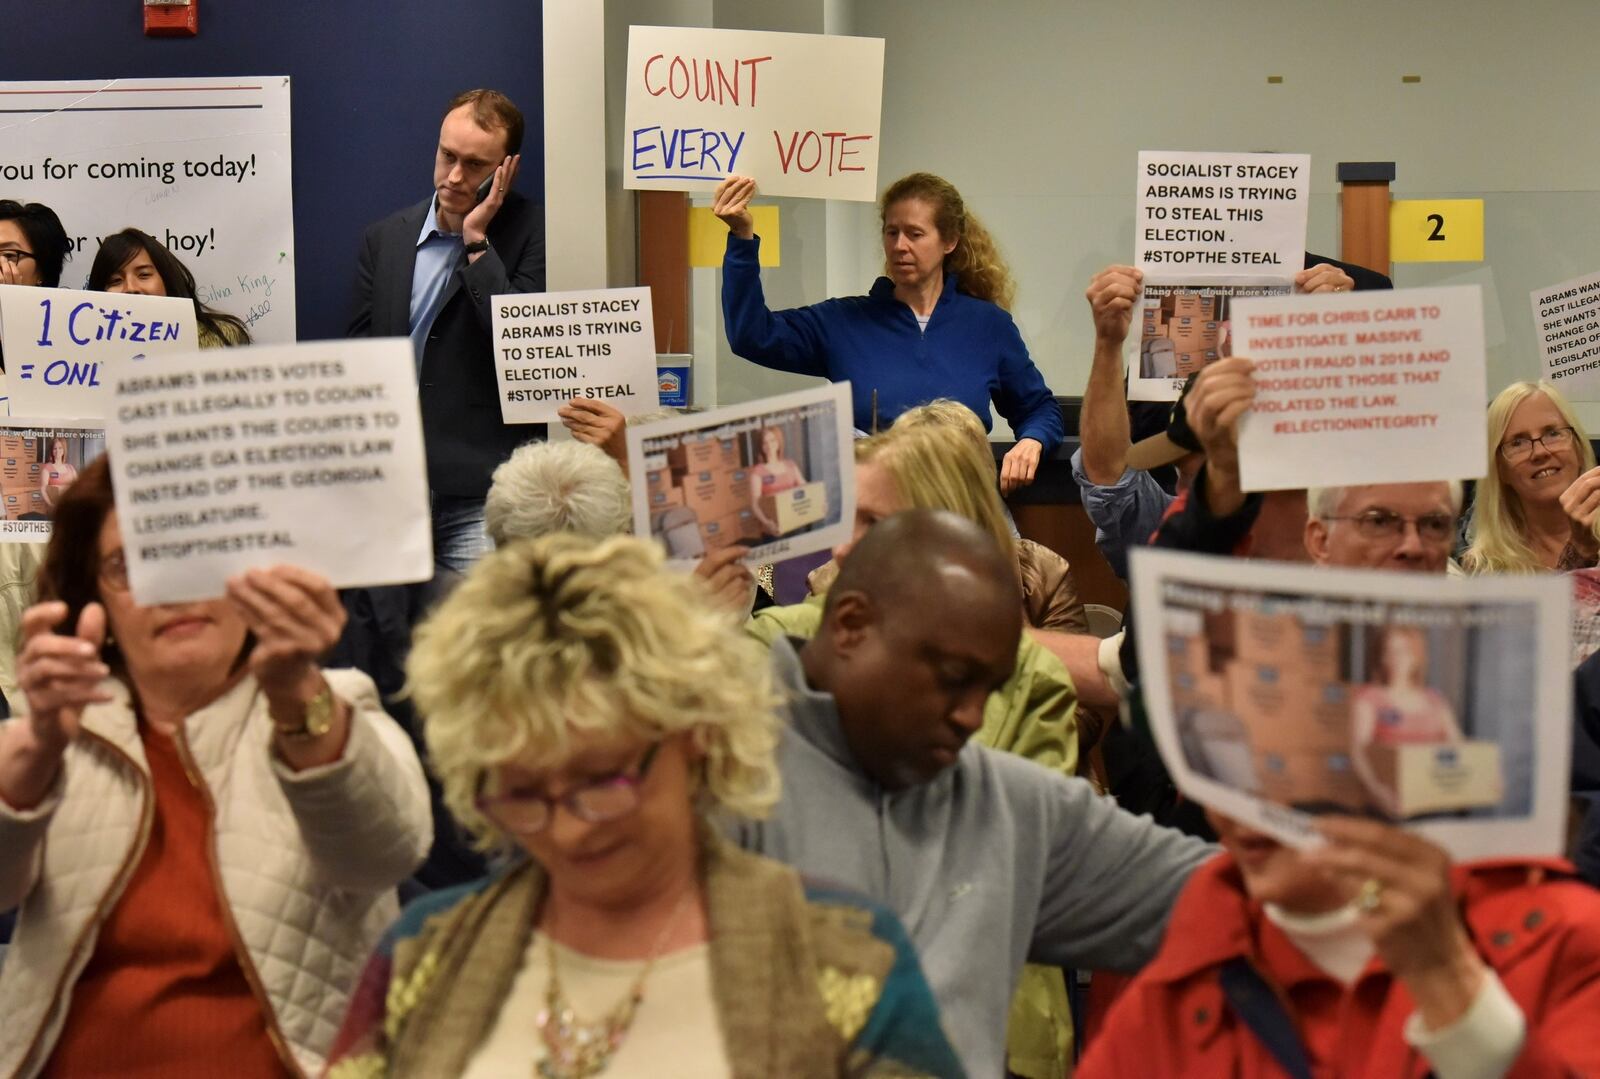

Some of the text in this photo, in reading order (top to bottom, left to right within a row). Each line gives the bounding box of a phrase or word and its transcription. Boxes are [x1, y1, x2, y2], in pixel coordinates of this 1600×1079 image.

[644, 54, 772, 107] COUNT
[632, 126, 873, 177] EVERY VOTE
[43, 158, 78, 180] for
[87, 158, 175, 185] coming
[183, 154, 256, 183] today!
[1147, 163, 1299, 179] SOCIALIST STACEY
[1146, 185, 1297, 200] ABRAMS IS TRYING
[1145, 207, 1263, 221] TO STEAL THIS
[1145, 229, 1225, 242] ELECTION
[1427, 213, 1445, 241] 2
[63, 236, 88, 252] or
[165, 228, 216, 257] hoy!
[1143, 251, 1282, 265] #STOPTHE STEAL
[237, 274, 276, 297] King
[1144, 287, 1171, 297] Hang
[1205, 287, 1234, 296] found
[1540, 289, 1578, 305] ABRAMS
[1541, 293, 1600, 318] CAST ILLEGA
[500, 299, 640, 319] SOCIALIST STACEY
[1248, 305, 1440, 328] TIME FOR CHRIS CARR TO
[1543, 319, 1563, 331] SHE
[1563, 308, 1597, 325] WANTS
[37, 299, 52, 347] 1
[501, 320, 642, 340] ABRAMS IS TRYING
[1545, 321, 1600, 342] CHANGE GA
[1248, 329, 1422, 351] INVESTIGATE MASSIVE
[1547, 333, 1600, 354] INSTEAD OF
[502, 343, 612, 361] TO STEAL THIS
[1304, 354, 1356, 369] FRAUD
[1359, 353, 1375, 367] IN
[1379, 351, 1415, 366] 2018
[1418, 349, 1450, 363] AND
[1549, 346, 1600, 368] LEGISLATU
[44, 360, 104, 387] ONL
[116, 360, 346, 396] ABRAMS WANTS VOTES
[505, 366, 578, 382] ELECTION
[1347, 373, 1397, 387] THOSE
[1402, 370, 1441, 384] THAT
[1551, 361, 1600, 379] #STOPTHE
[507, 384, 636, 403] #STOPTHE STEAL
[1330, 395, 1359, 409] THE
[118, 401, 168, 424] CAST
[172, 391, 278, 416] ILLEGALLY
[283, 388, 311, 406] TO
[122, 412, 400, 450] SHE WANTS THE COURTS TO
[1273, 414, 1438, 434] #ELECTIONINTEGRITY
[126, 439, 395, 479] CHANGE GA ELECTION LAW
[129, 466, 384, 505] INSTEAD OF THE GEORGIA
[3, 522, 53, 533] #STOPTHES
[140, 532, 294, 560] #STOPTHESTEAL
